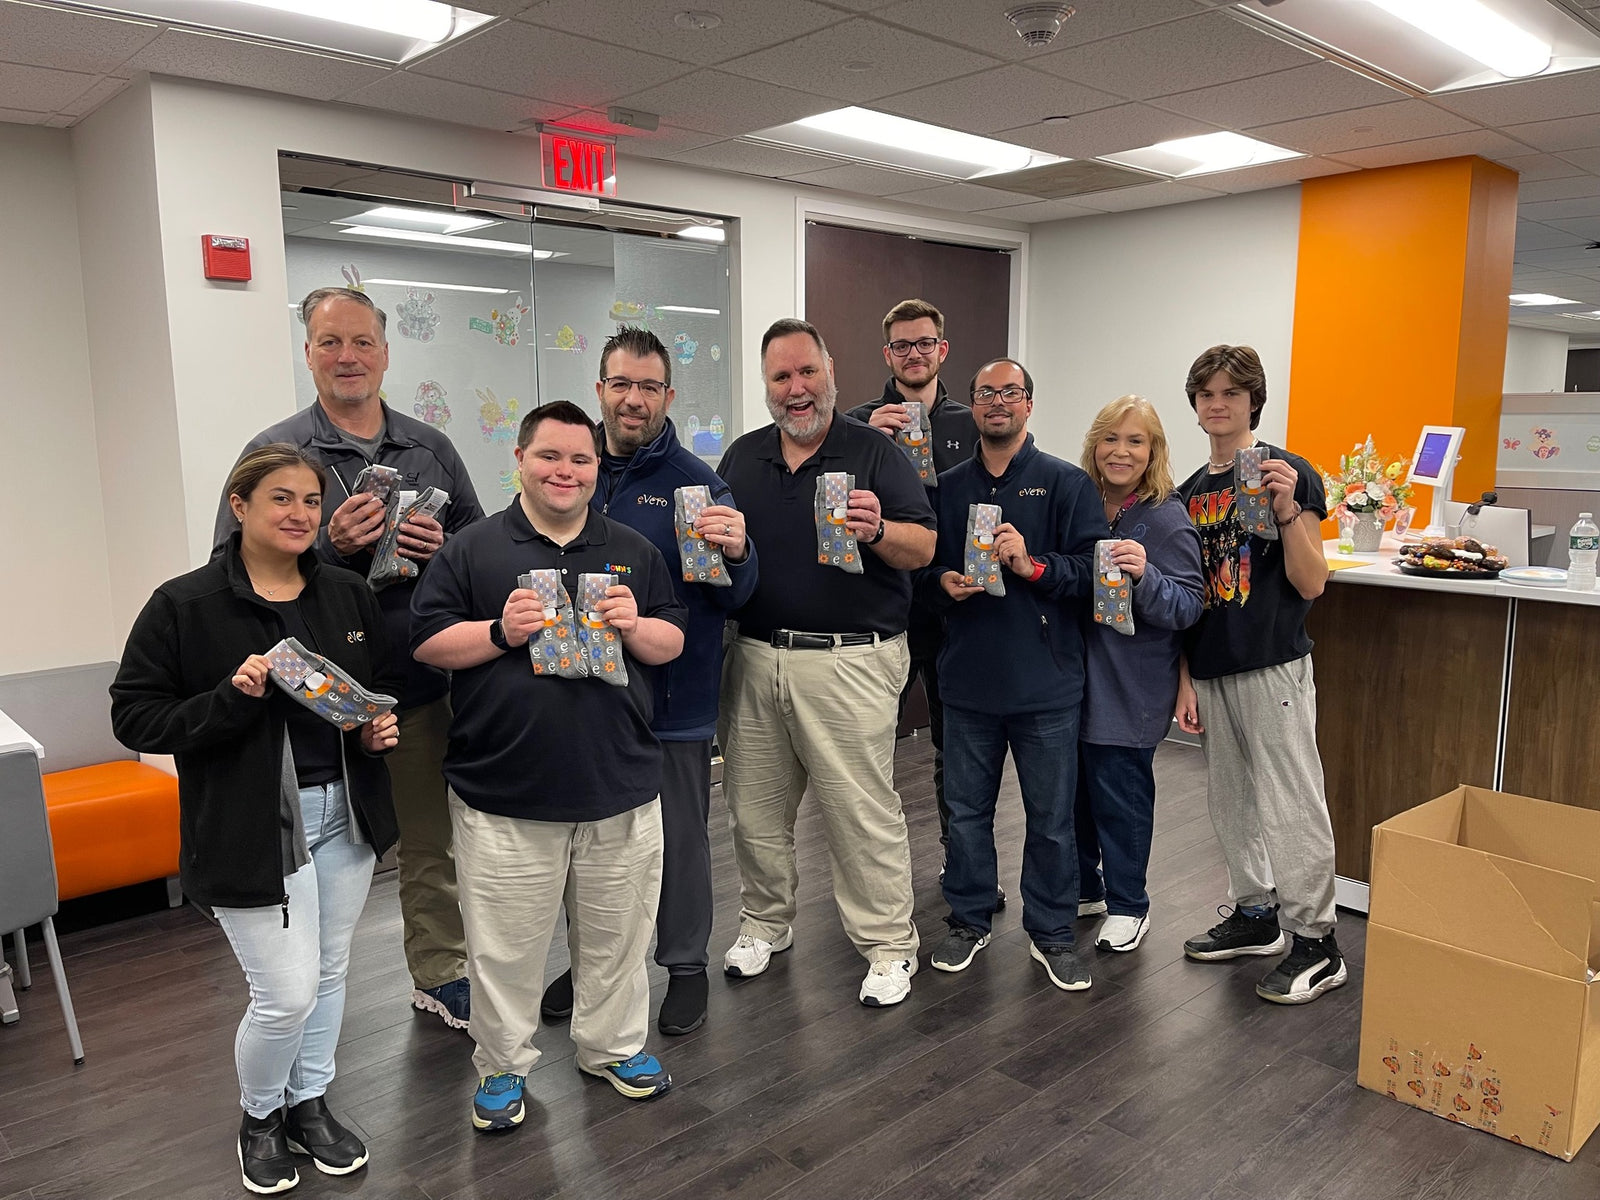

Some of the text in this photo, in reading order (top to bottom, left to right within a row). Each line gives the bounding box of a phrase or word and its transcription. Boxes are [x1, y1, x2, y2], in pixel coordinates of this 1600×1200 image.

[553, 137, 606, 193] EXIT
[1018, 487, 1047, 497] eVero
[637, 493, 668, 508] eVero
[346, 630, 366, 644] eVe
